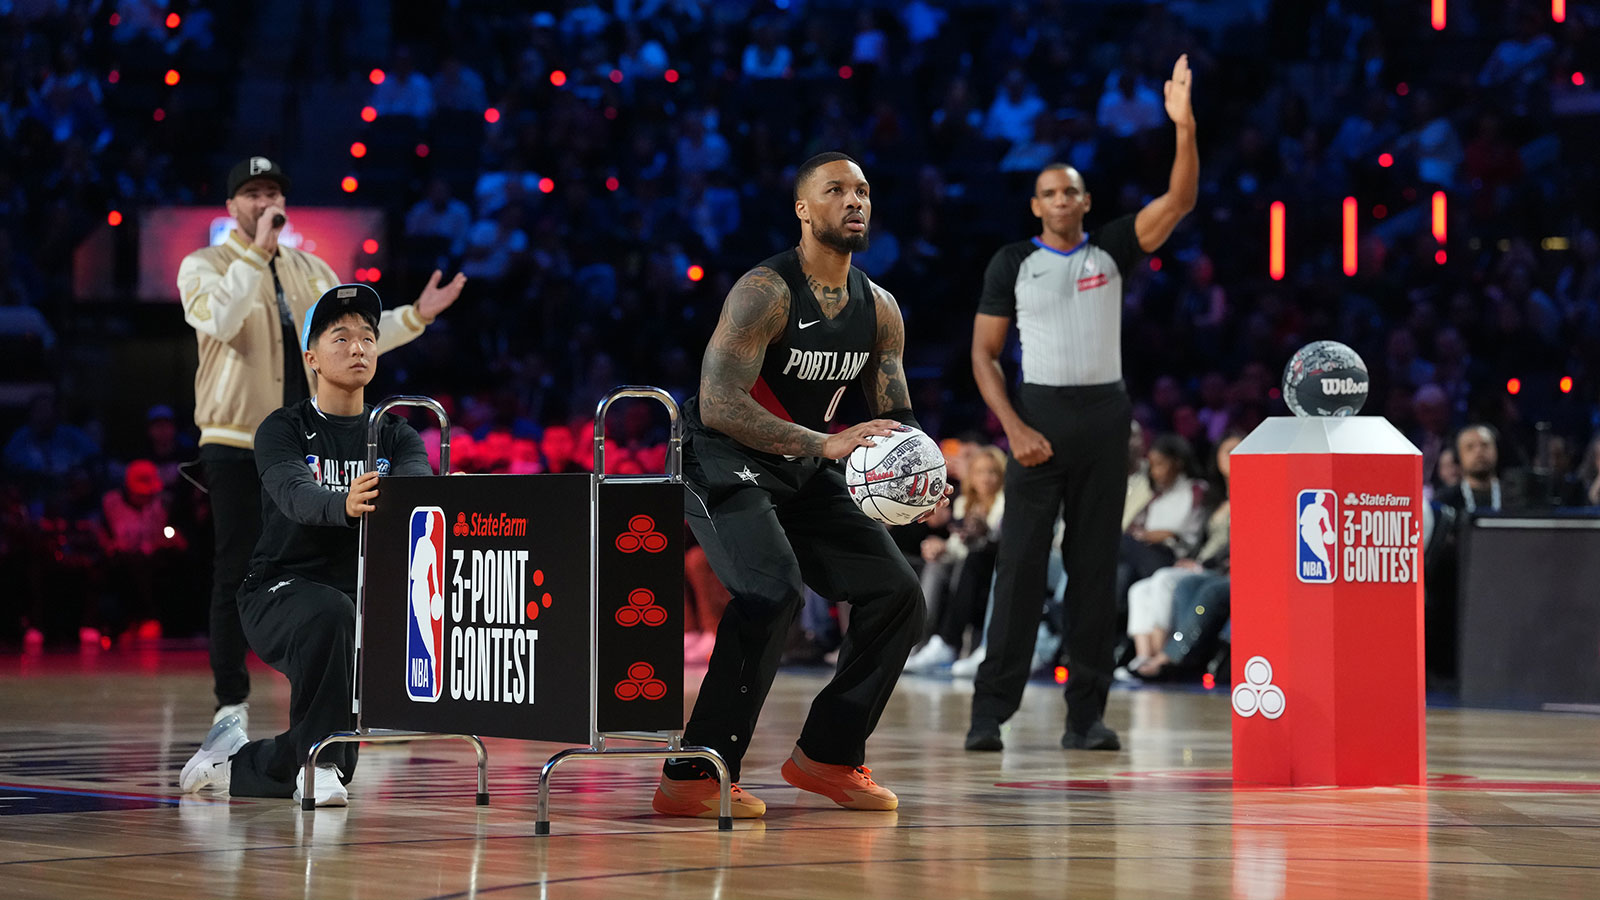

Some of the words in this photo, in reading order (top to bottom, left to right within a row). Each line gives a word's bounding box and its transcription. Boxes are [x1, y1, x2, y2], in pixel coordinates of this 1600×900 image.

[824, 385, 847, 423] 0
[1343, 510, 1412, 547] 3-POINT
[1302, 561, 1323, 577] NBA
[1343, 546, 1418, 583] CONTEST
[451, 549, 529, 625] 3-POINT
[411, 658, 429, 688] NBA
[450, 626, 539, 705] CONTEST
